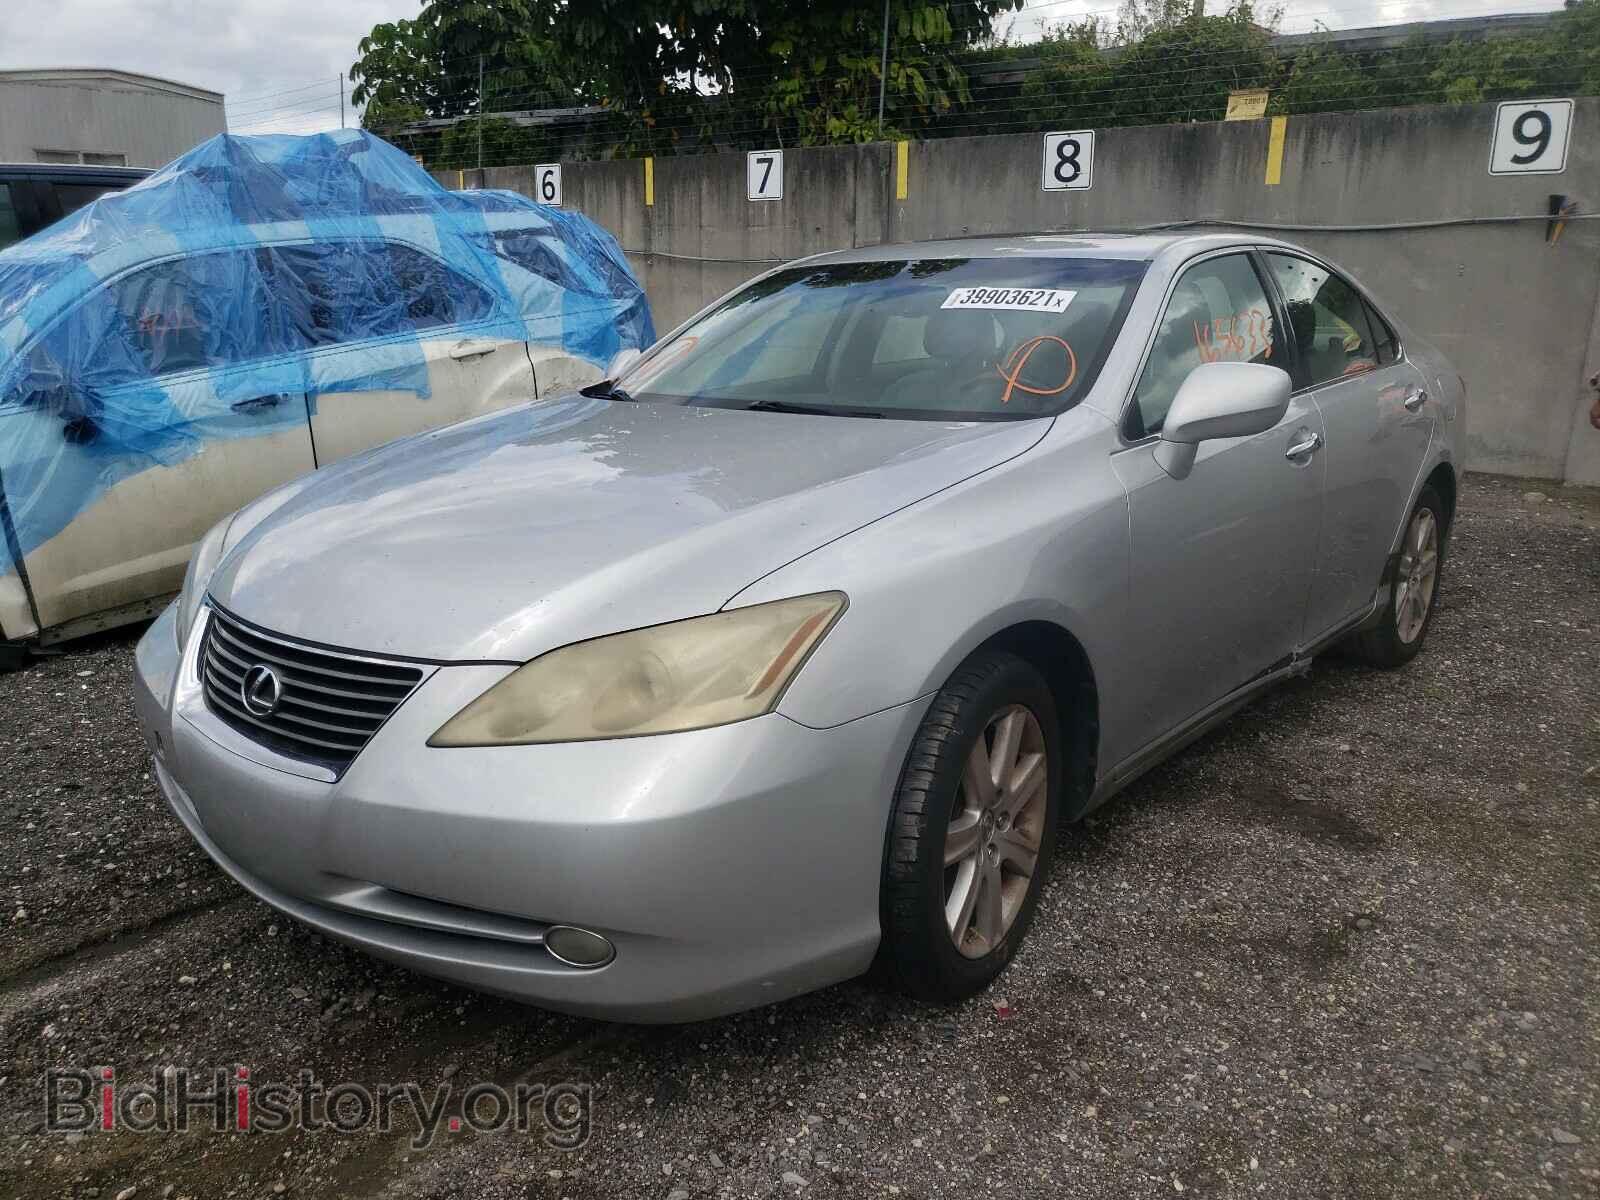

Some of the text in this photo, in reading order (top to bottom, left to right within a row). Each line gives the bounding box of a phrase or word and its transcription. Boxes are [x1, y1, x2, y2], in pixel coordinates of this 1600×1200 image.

[1510, 109, 1553, 165] 9
[756, 157, 774, 194] 7
[1054, 139, 1081, 183] 8
[541, 169, 556, 201] 6
